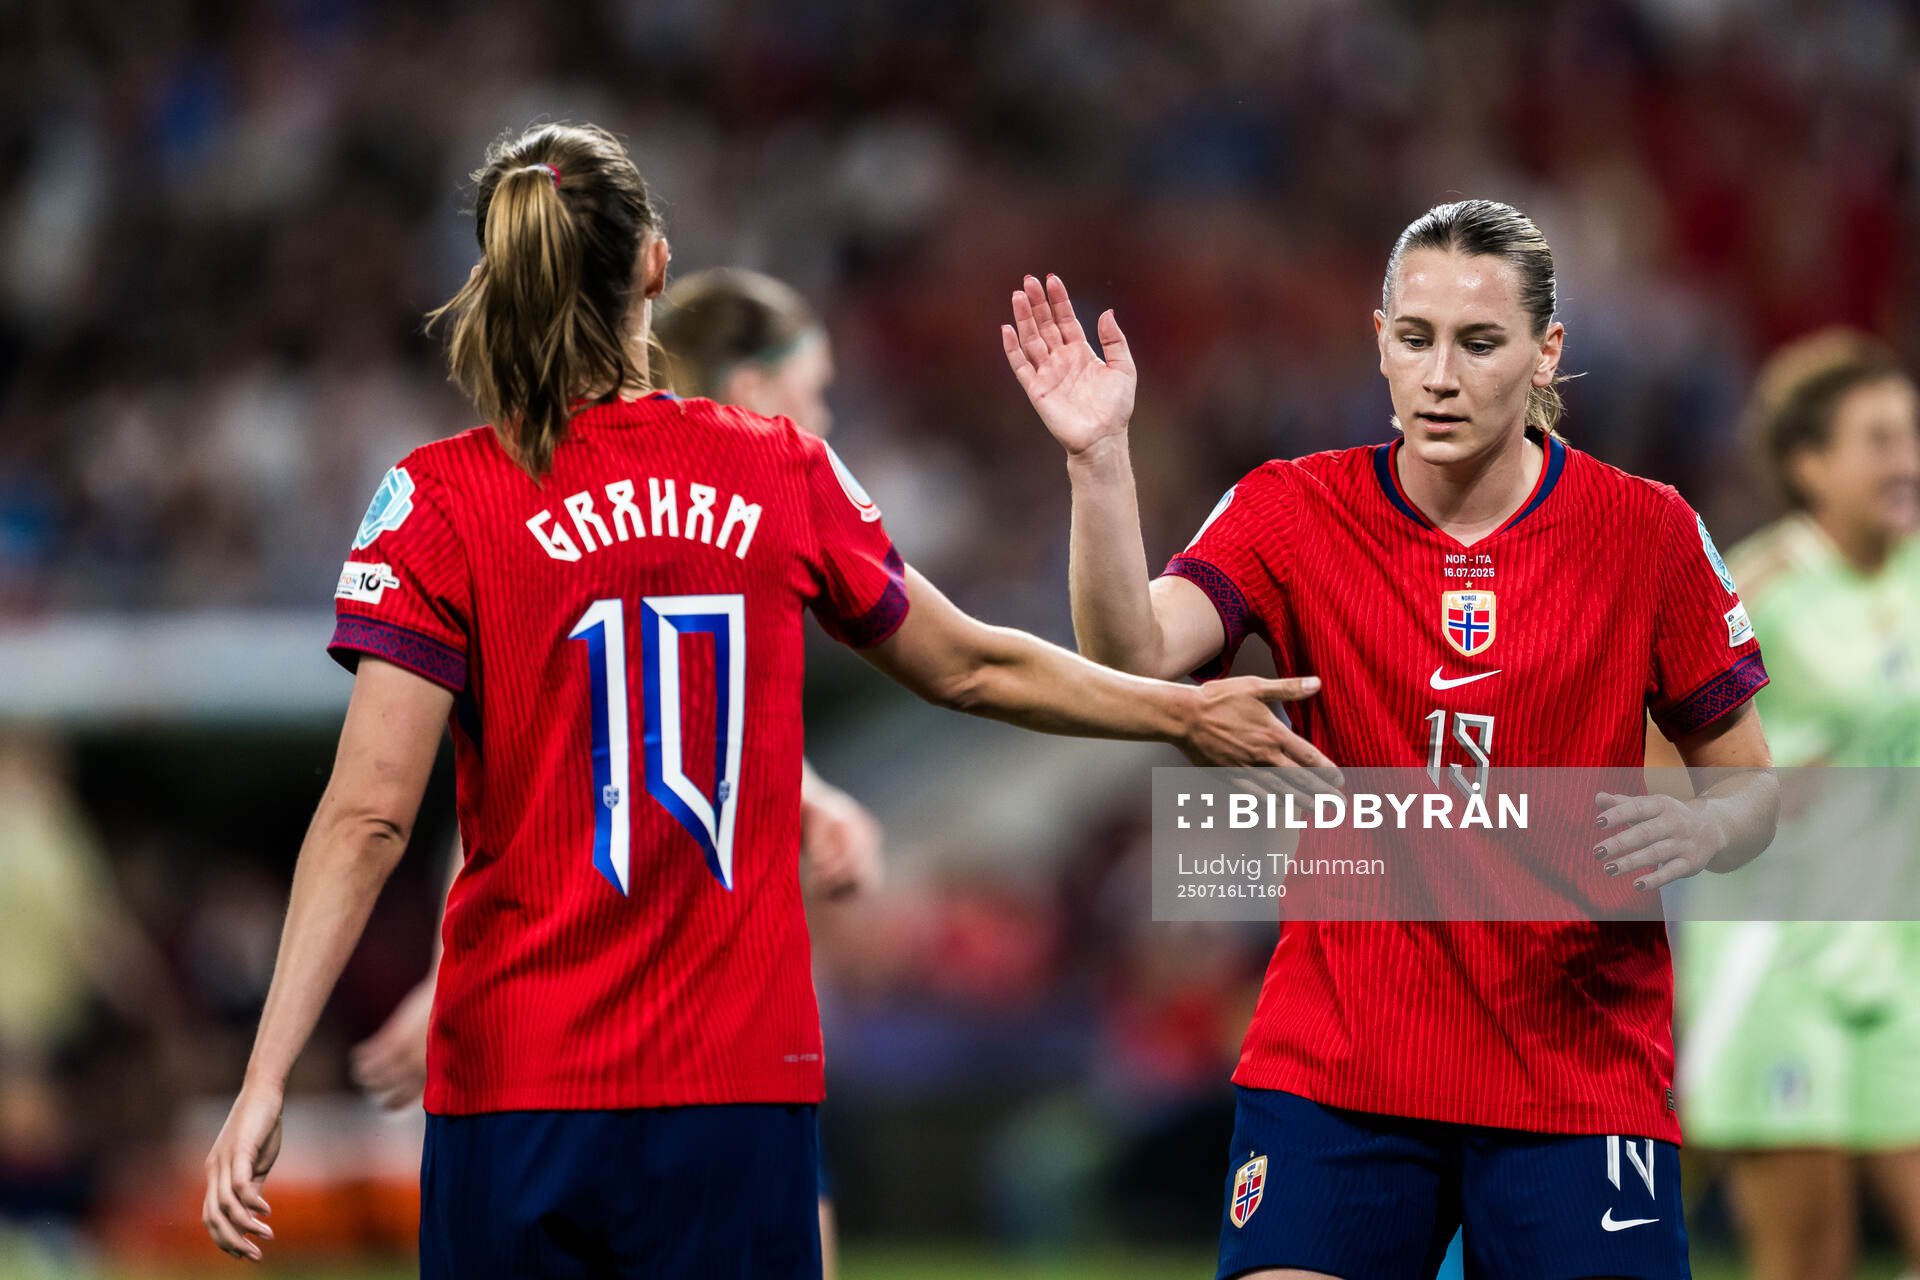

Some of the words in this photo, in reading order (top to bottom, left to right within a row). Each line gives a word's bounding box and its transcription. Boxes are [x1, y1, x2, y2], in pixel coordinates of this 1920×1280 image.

[525, 477, 763, 562] GRAHAM
[1443, 567, 1495, 577] 16.07.2025
[1445, 554, 1467, 564] NOR
[1476, 554, 1492, 564] ITA
[567, 594, 746, 897] 10
